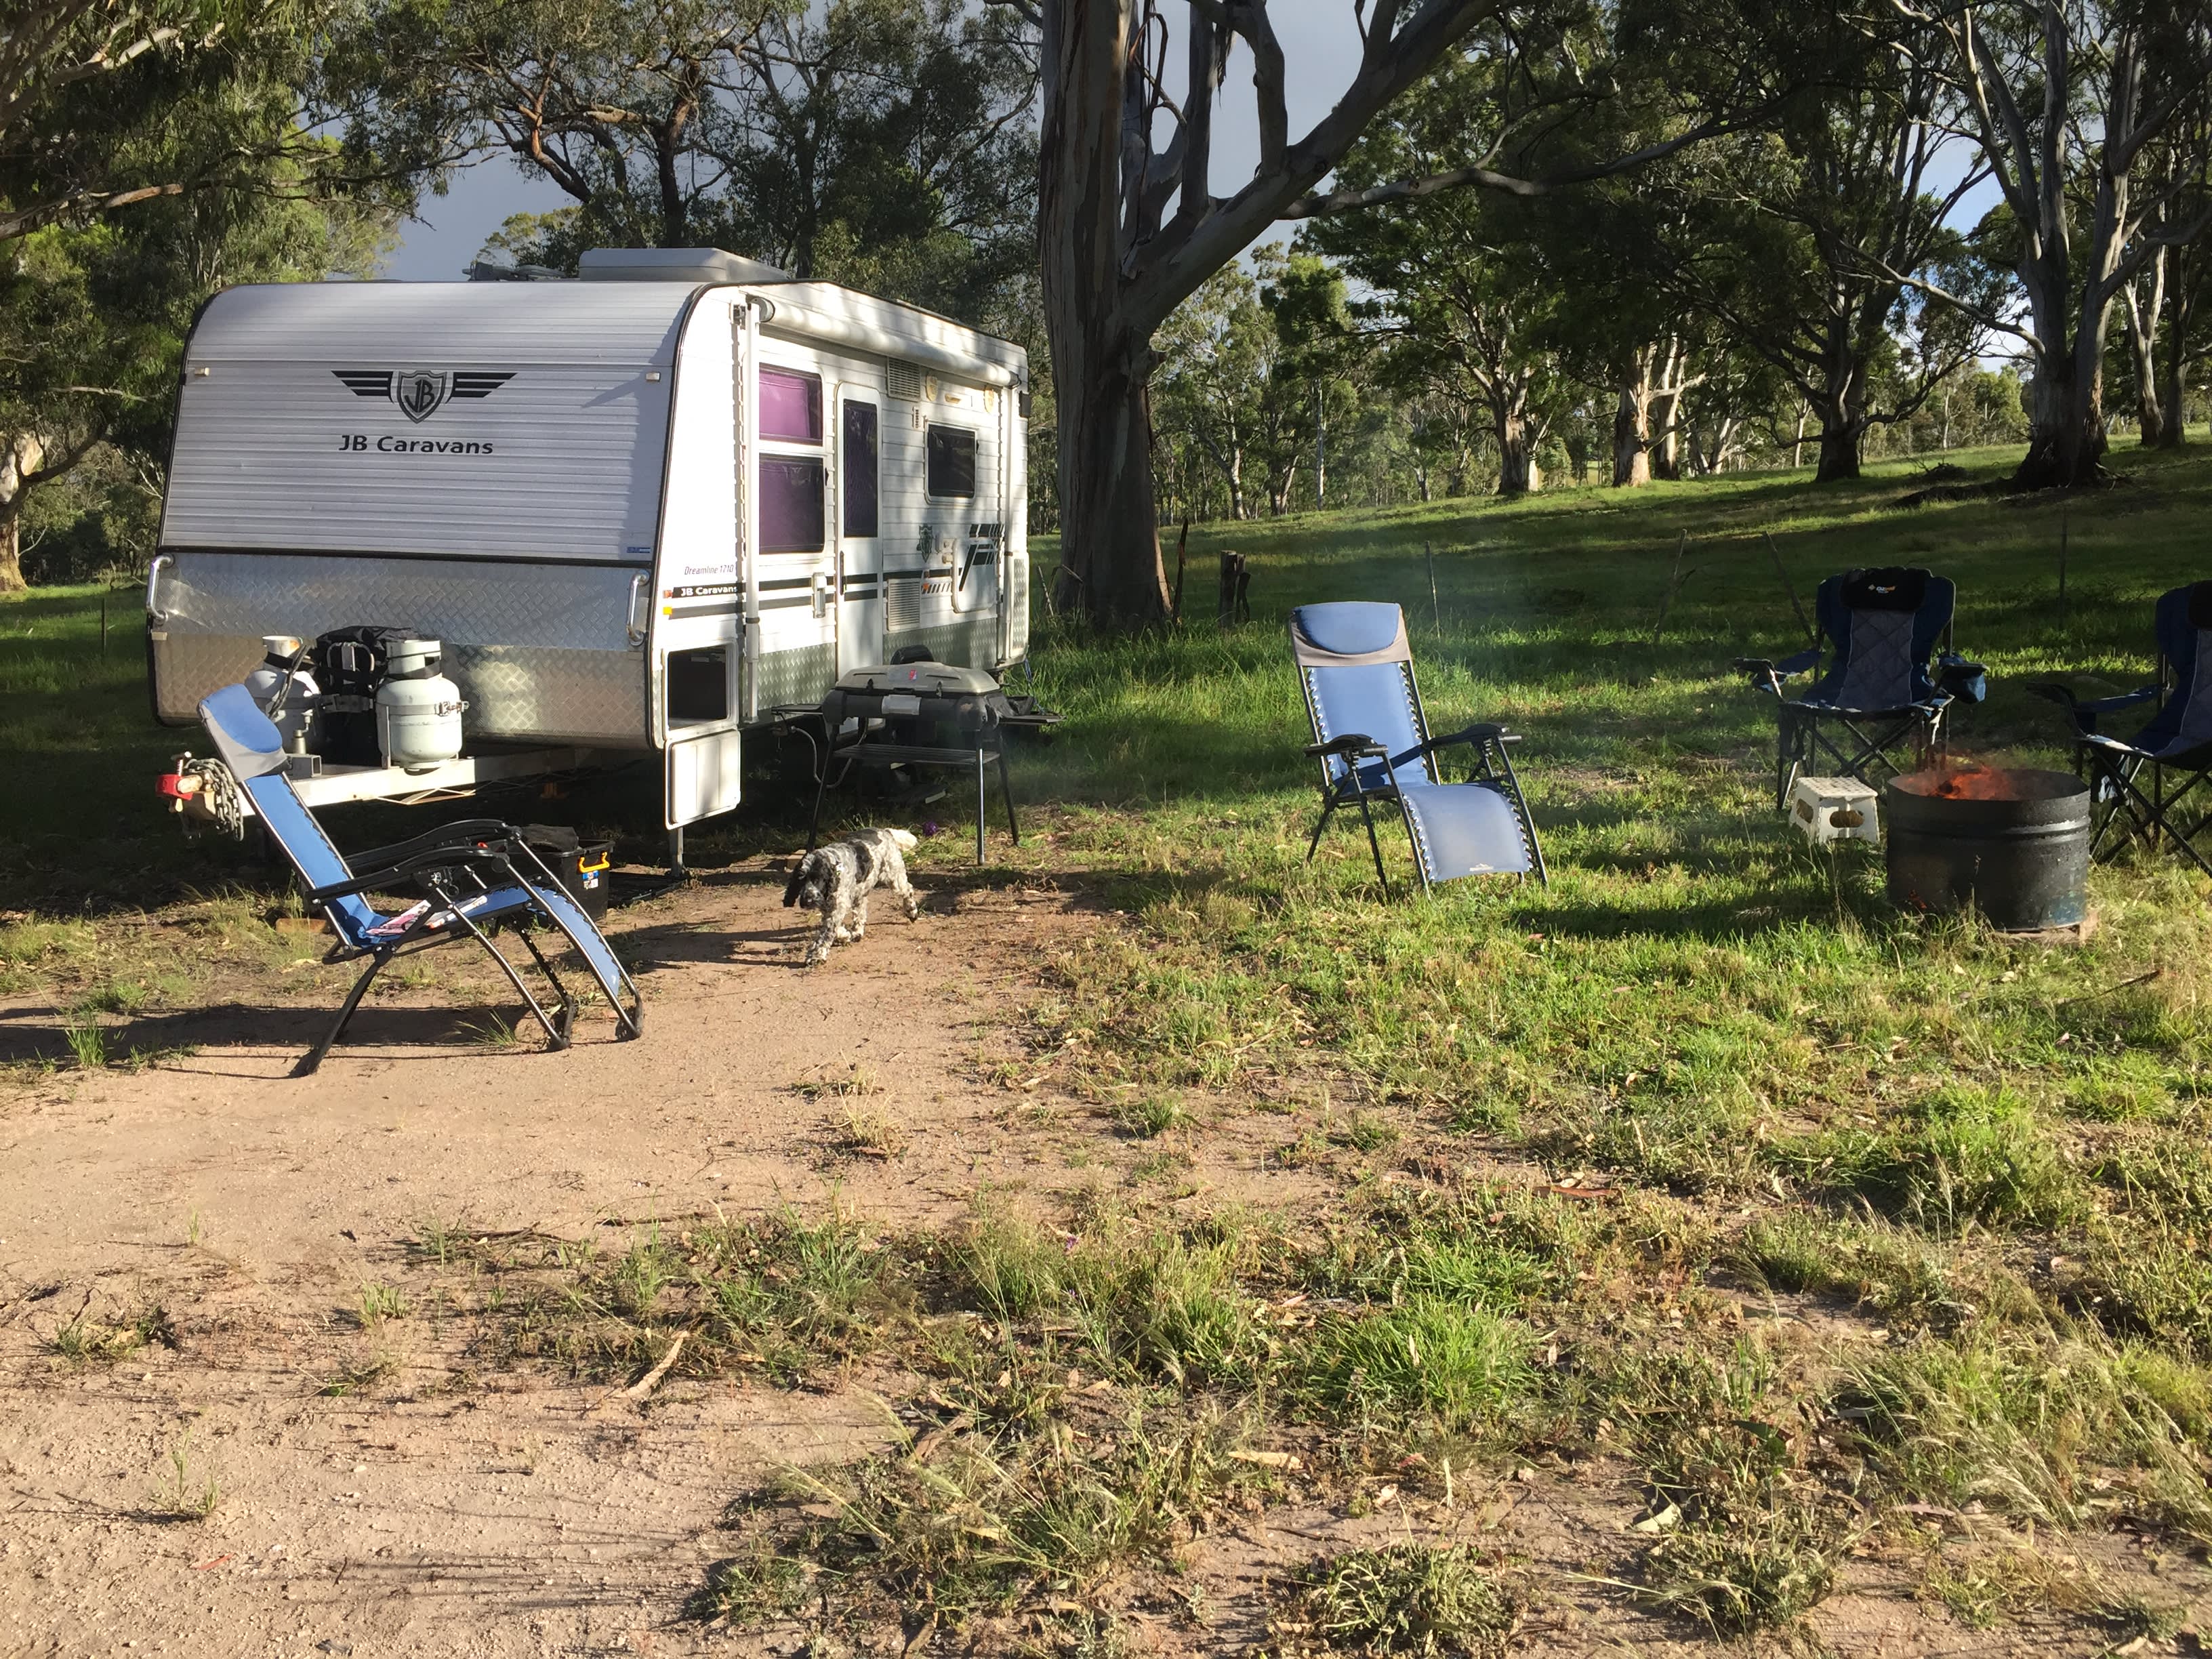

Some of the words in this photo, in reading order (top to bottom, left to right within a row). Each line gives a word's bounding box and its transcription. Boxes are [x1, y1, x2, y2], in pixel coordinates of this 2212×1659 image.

[405, 379, 435, 413] JB
[339, 435, 367, 451] JB
[377, 436, 493, 455] Caravans
[684, 566, 718, 575] Dreamline
[720, 564, 734, 573] 1710
[681, 588, 693, 596] JB
[695, 586, 737, 595] Caravans
